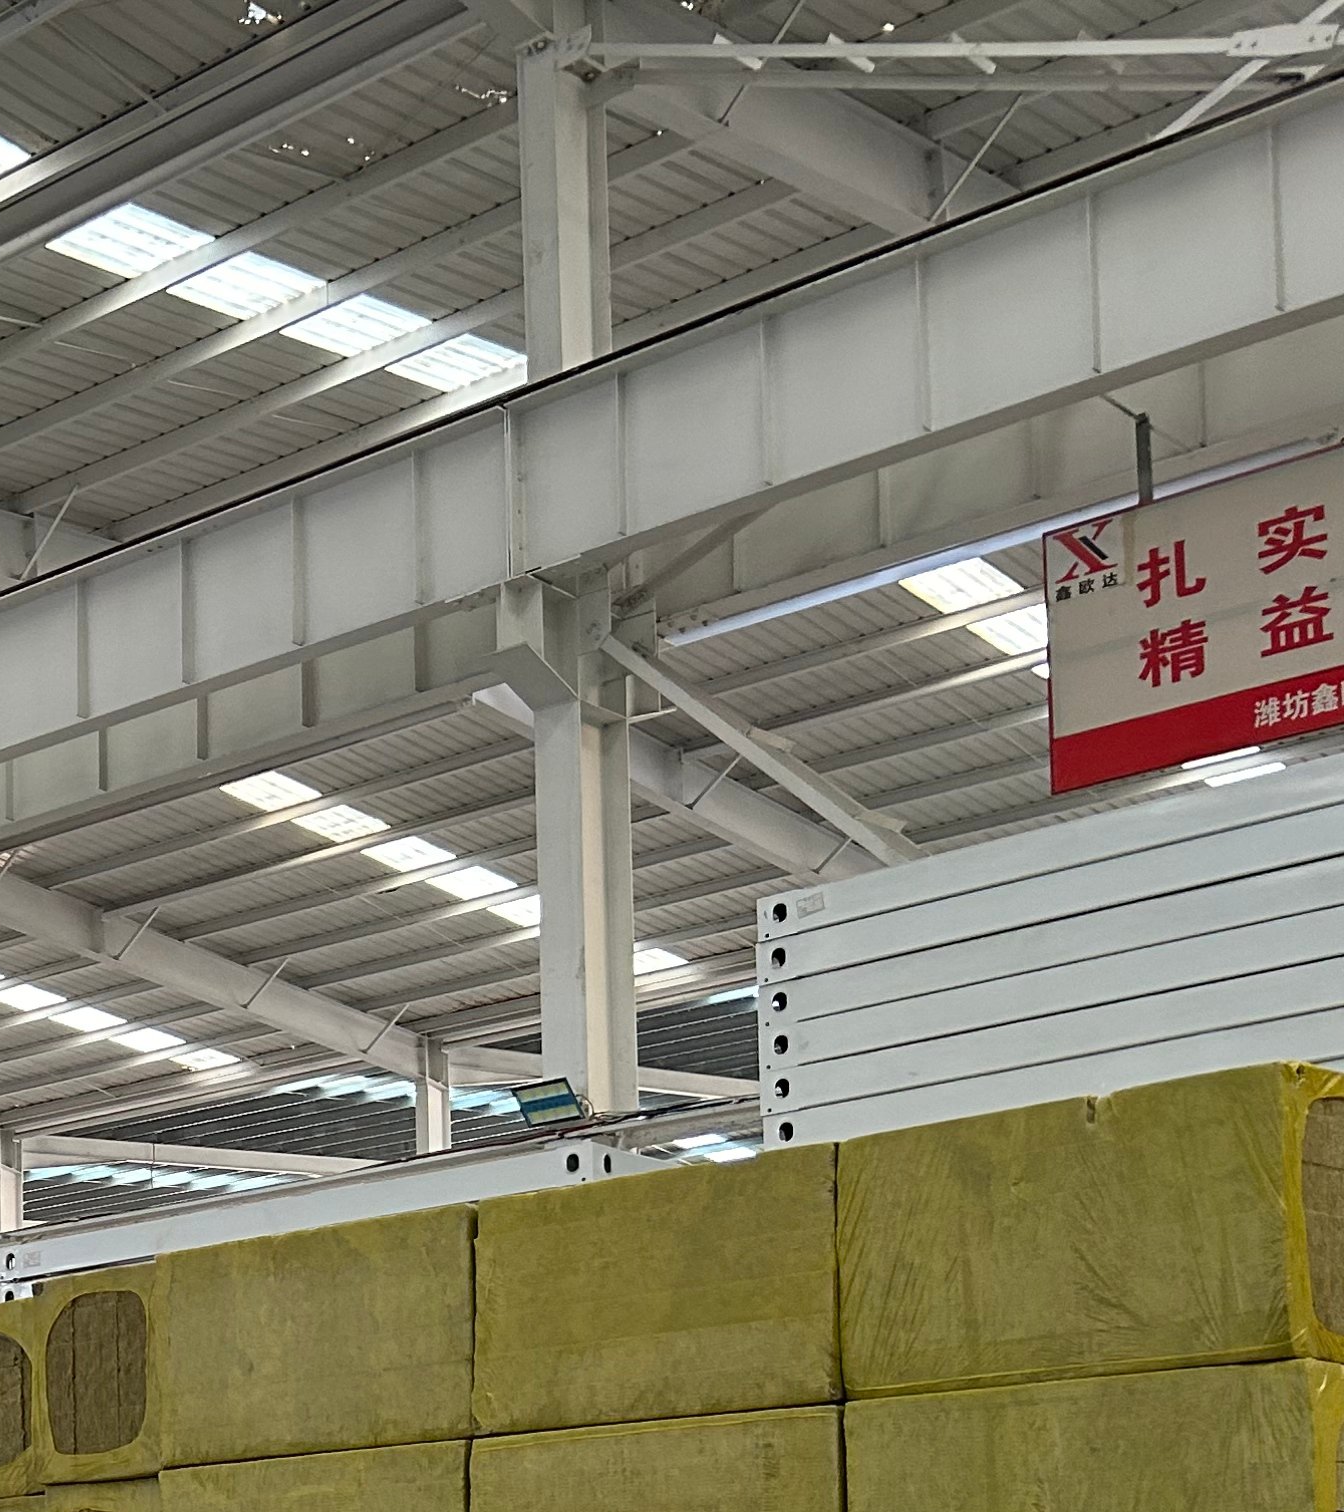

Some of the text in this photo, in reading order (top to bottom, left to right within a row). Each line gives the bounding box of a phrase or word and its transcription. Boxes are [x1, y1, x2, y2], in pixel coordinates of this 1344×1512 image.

[1056, 572, 1118, 602] 鑫欧达
[1137, 505, 1328, 608] 扎实
[1138, 586, 1334, 688] 精益
[1254, 680, 1344, 728] 潍坊鑫
